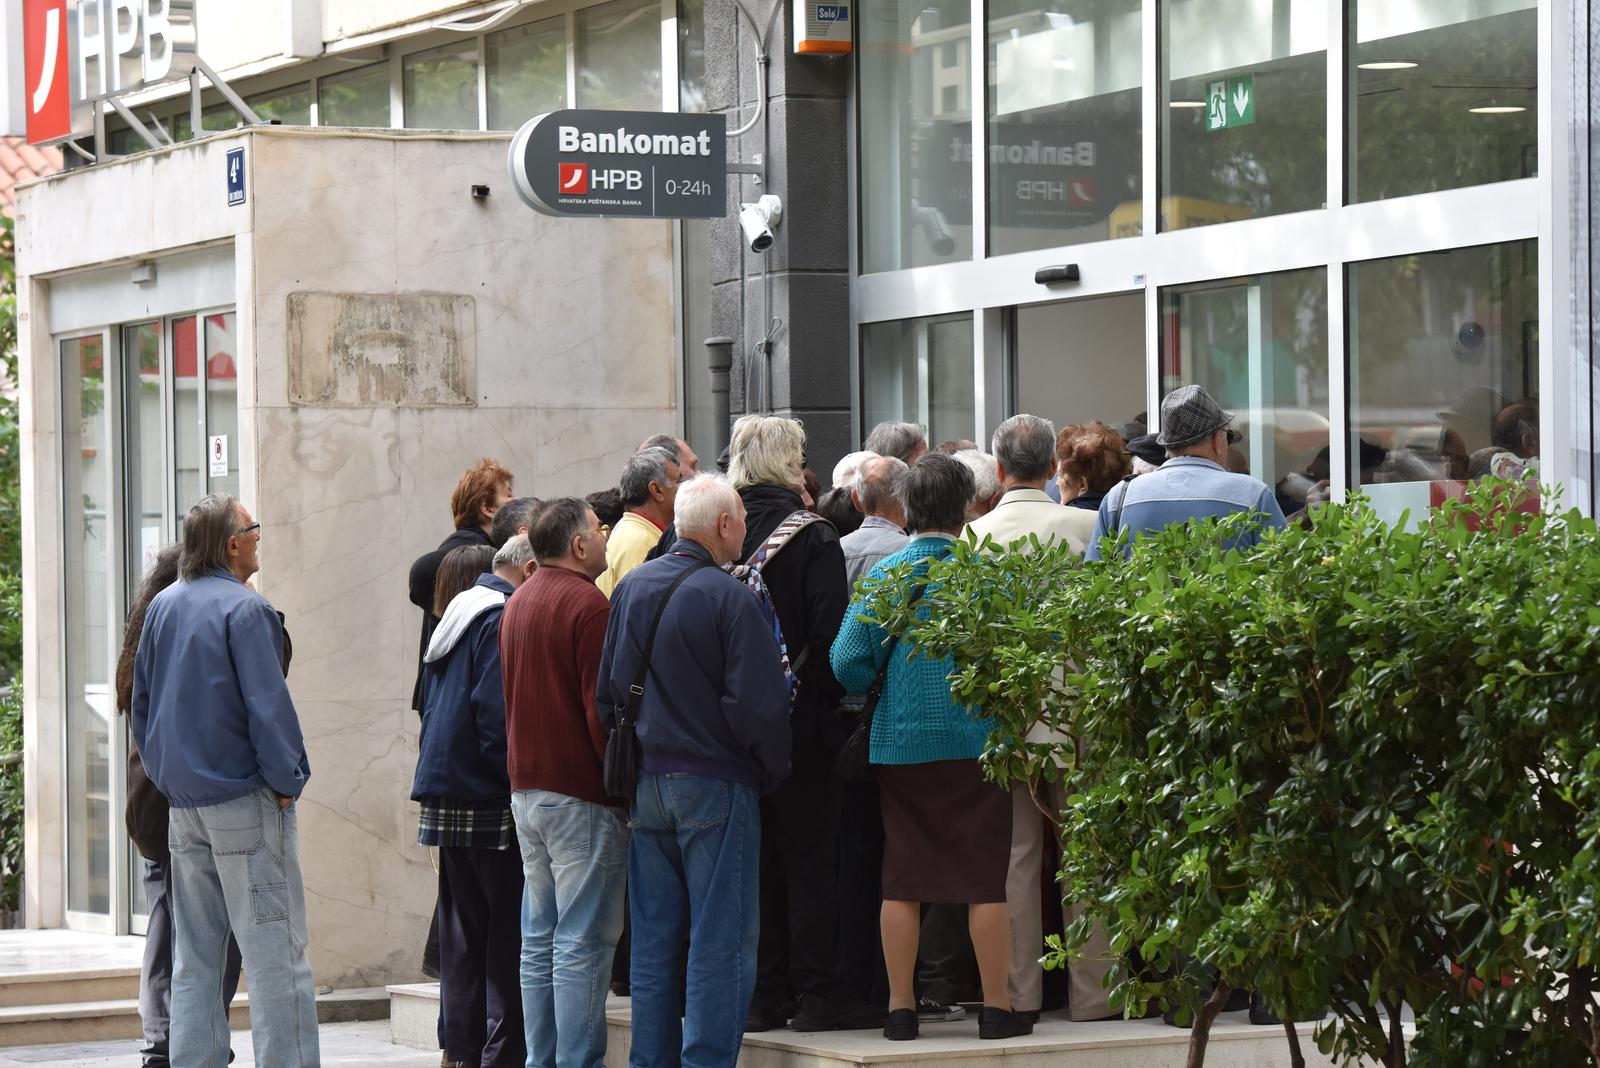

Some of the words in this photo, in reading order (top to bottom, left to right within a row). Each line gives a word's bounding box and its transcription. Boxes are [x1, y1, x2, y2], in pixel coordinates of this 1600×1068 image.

[819, 7, 836, 18] Solo
[79, 0, 173, 100] HPB
[558, 126, 711, 156] Bankomat
[591, 169, 643, 190] HPB
[665, 179, 711, 196] 0-24h
